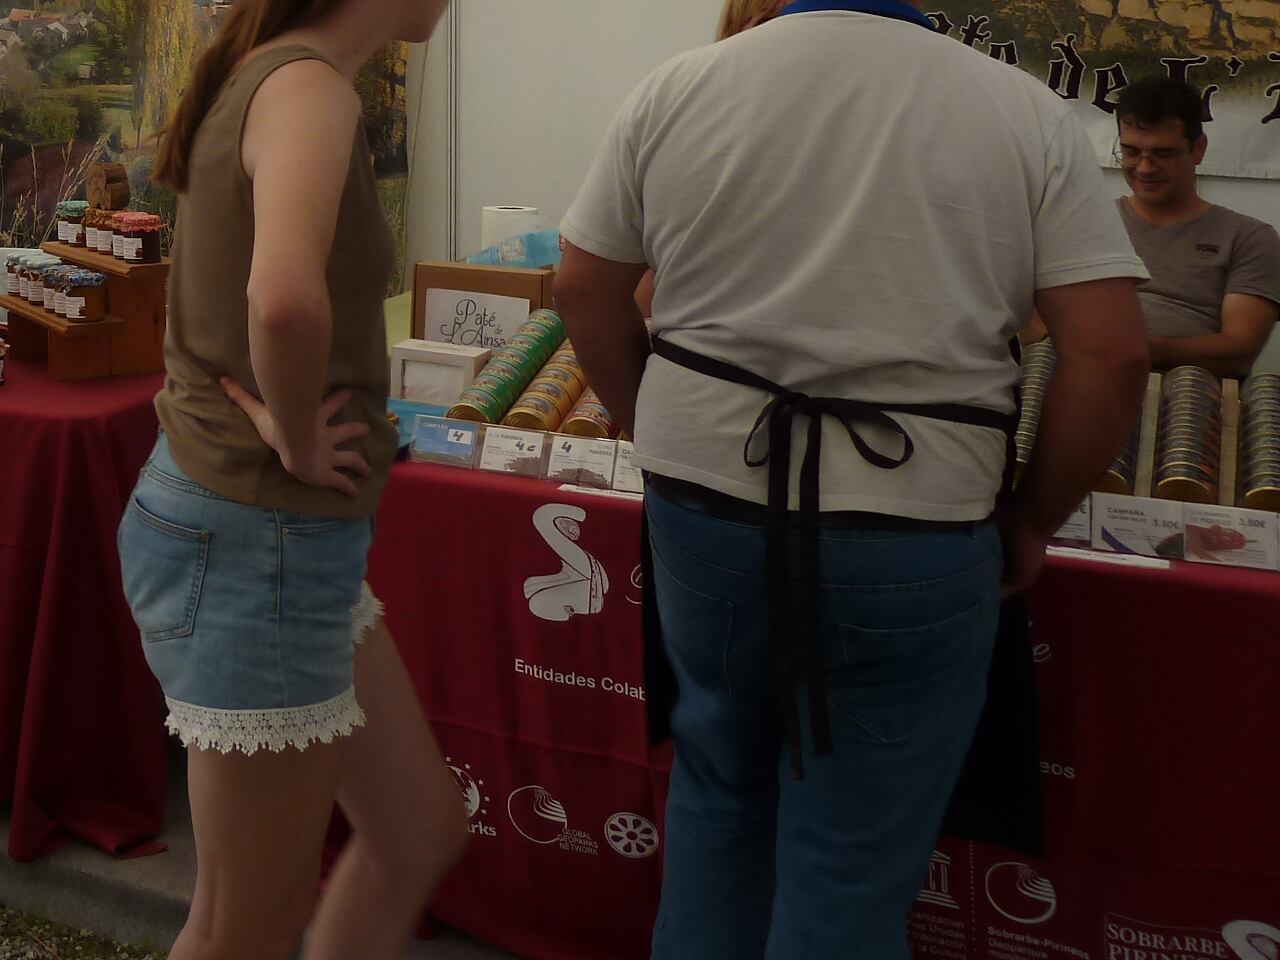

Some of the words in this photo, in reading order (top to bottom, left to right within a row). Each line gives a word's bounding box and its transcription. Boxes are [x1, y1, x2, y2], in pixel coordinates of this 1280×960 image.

[454, 298, 497, 328] Paté
[514, 658, 596, 689] Entidades
[601, 677, 646, 701] Colab
[1107, 922, 1229, 959] SOBRARBE
